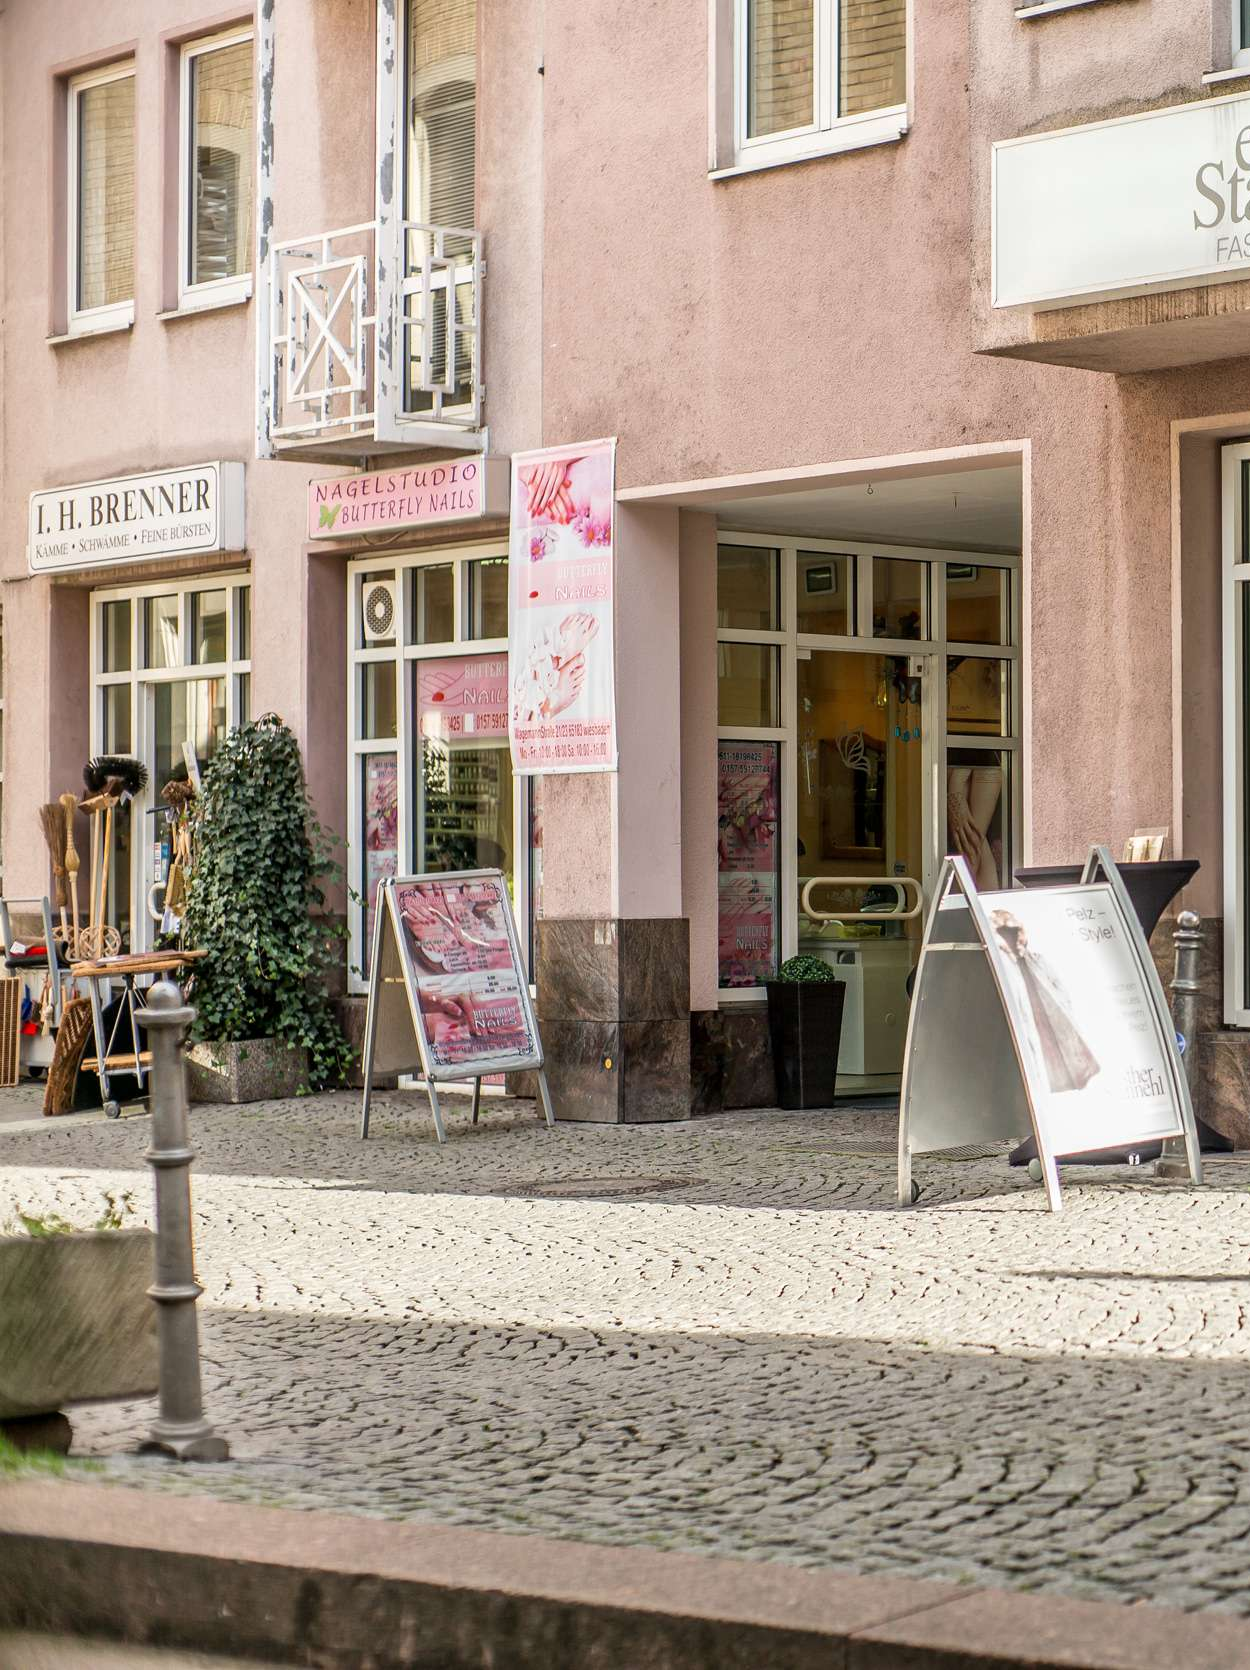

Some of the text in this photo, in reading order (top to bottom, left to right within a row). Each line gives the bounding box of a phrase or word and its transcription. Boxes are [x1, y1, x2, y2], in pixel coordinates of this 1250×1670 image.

[316, 463, 477, 503] NAGELSTUDIO
[36, 478, 210, 535] I. H. BRENNER
[342, 489, 475, 524] BUTTERFLY NAILS
[141, 527, 168, 545] FEINE
[170, 521, 211, 540] BÜRSTEN
[462, 687, 509, 705] NAIL
